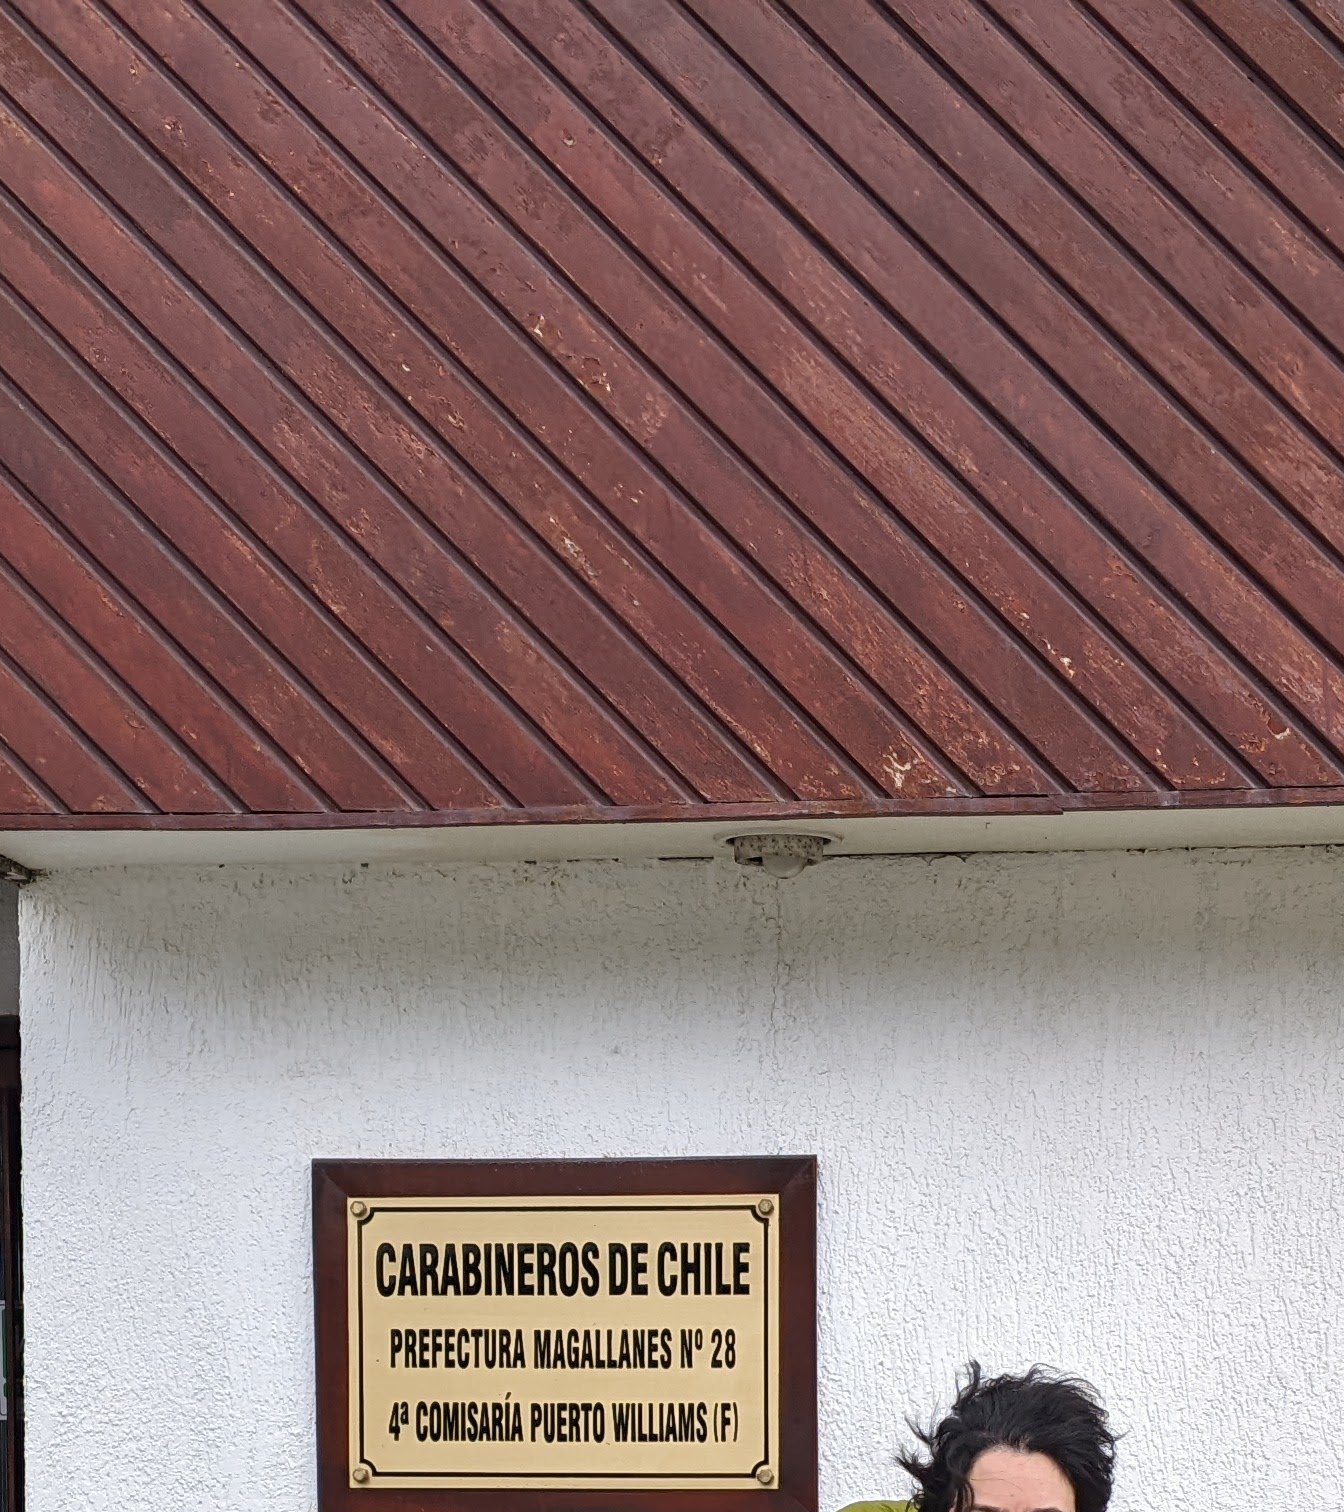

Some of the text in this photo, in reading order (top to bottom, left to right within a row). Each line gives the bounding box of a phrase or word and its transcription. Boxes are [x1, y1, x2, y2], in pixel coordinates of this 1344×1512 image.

[375, 1241, 751, 1298] CARABINEROS DE CHILE
[390, 1328, 527, 1370] PREFECTURA
[533, 1328, 673, 1370] MAGALLANES
[710, 1328, 736, 1370] 28
[388, 1391, 739, 1444] 4ª COMISARÍA PUERTO WILLIAMS (F)
